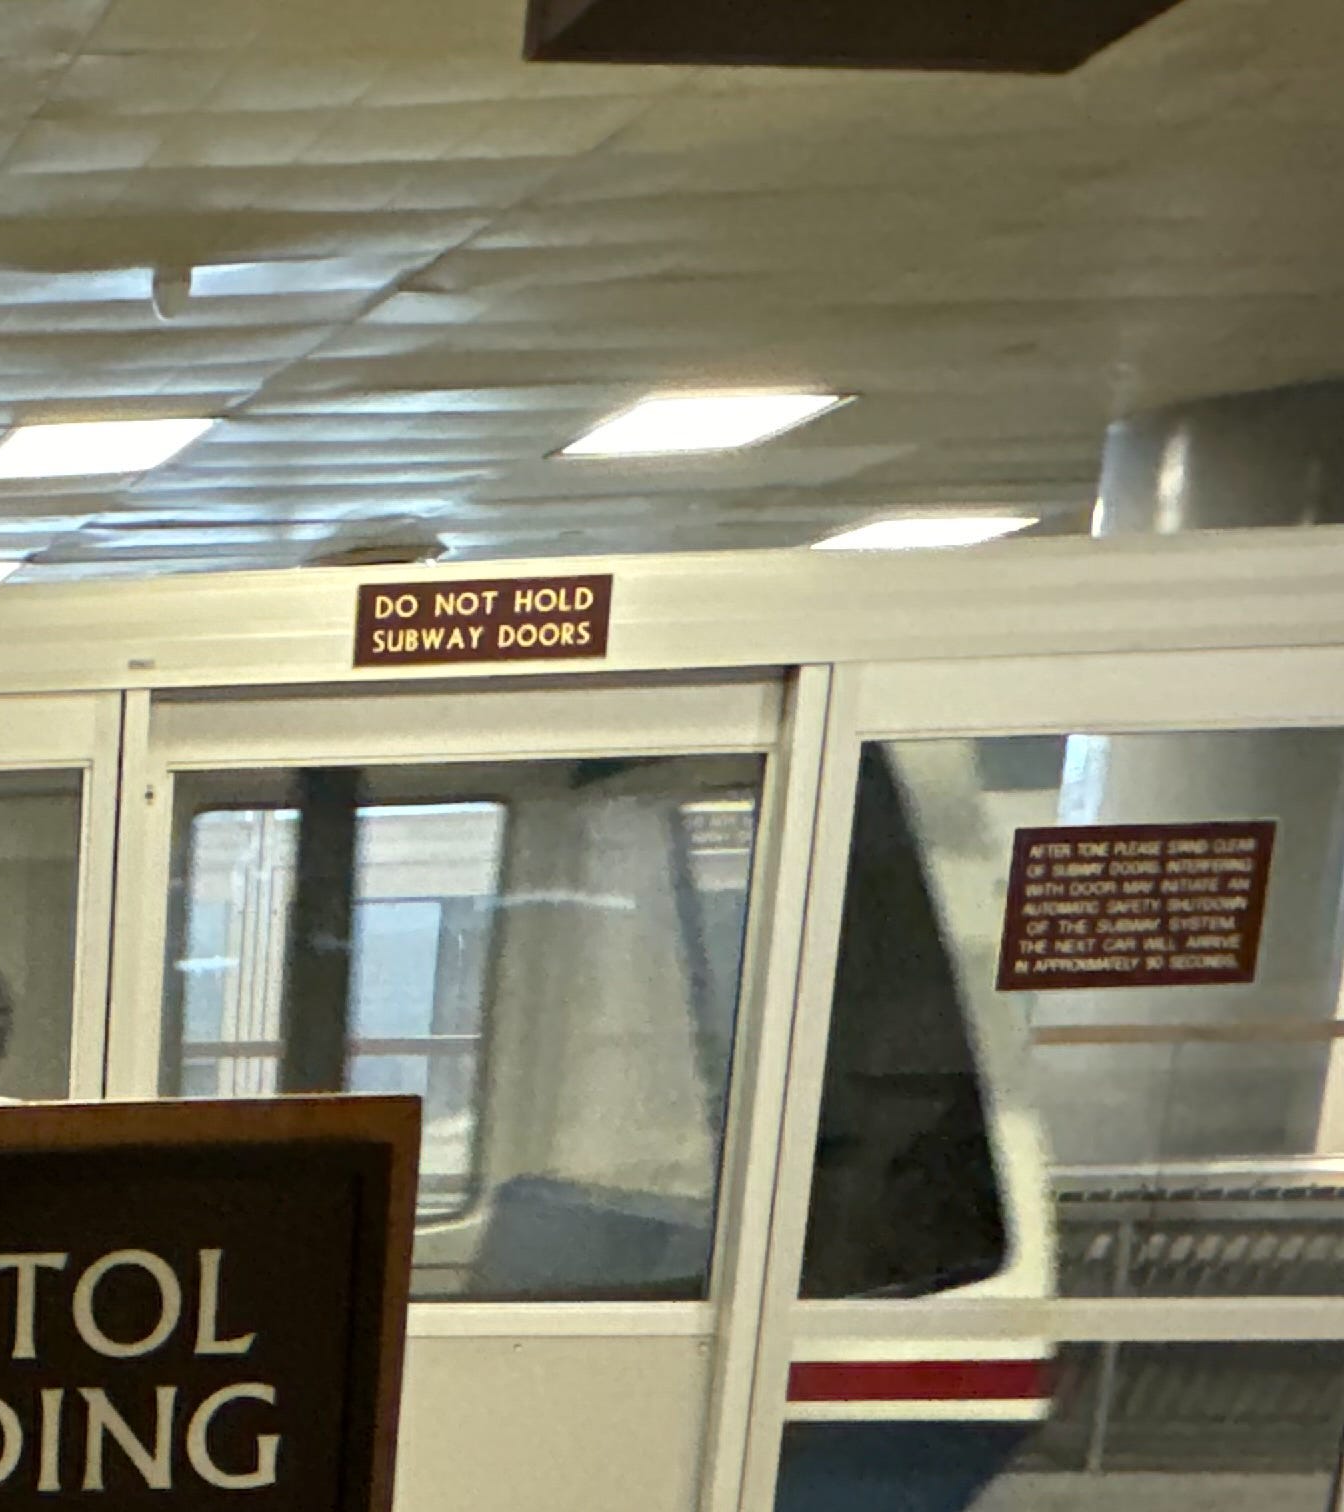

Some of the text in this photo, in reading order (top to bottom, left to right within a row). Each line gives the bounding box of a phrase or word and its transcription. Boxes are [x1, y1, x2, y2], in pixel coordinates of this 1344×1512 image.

[374, 587, 593, 619] DO NOT HOLD
[372, 621, 590, 653] SUBWAY DOORS
[1029, 838, 1256, 858] AFTER TONE PLEASE STAND CLEAR
[1027, 864, 1045, 878] OF
[1052, 862, 1104, 877] SUBWAY
[1166, 858, 1253, 873] INTERFERING
[1026, 878, 1251, 897] WITH DOOR MAY INITIATE AN
[1022, 896, 1248, 916] AUTOMATIC SAFETY SHUTDOWN
[1027, 921, 1049, 936] OF
[1059, 920, 1088, 934] THE
[1095, 919, 1161, 933] SUBWAY
[1020, 934, 1242, 954] THE NEXT CAR WILL ARRIVE
[1015, 959, 1029, 973] IN
[1033, 957, 1140, 972] APPROXIMATELY
